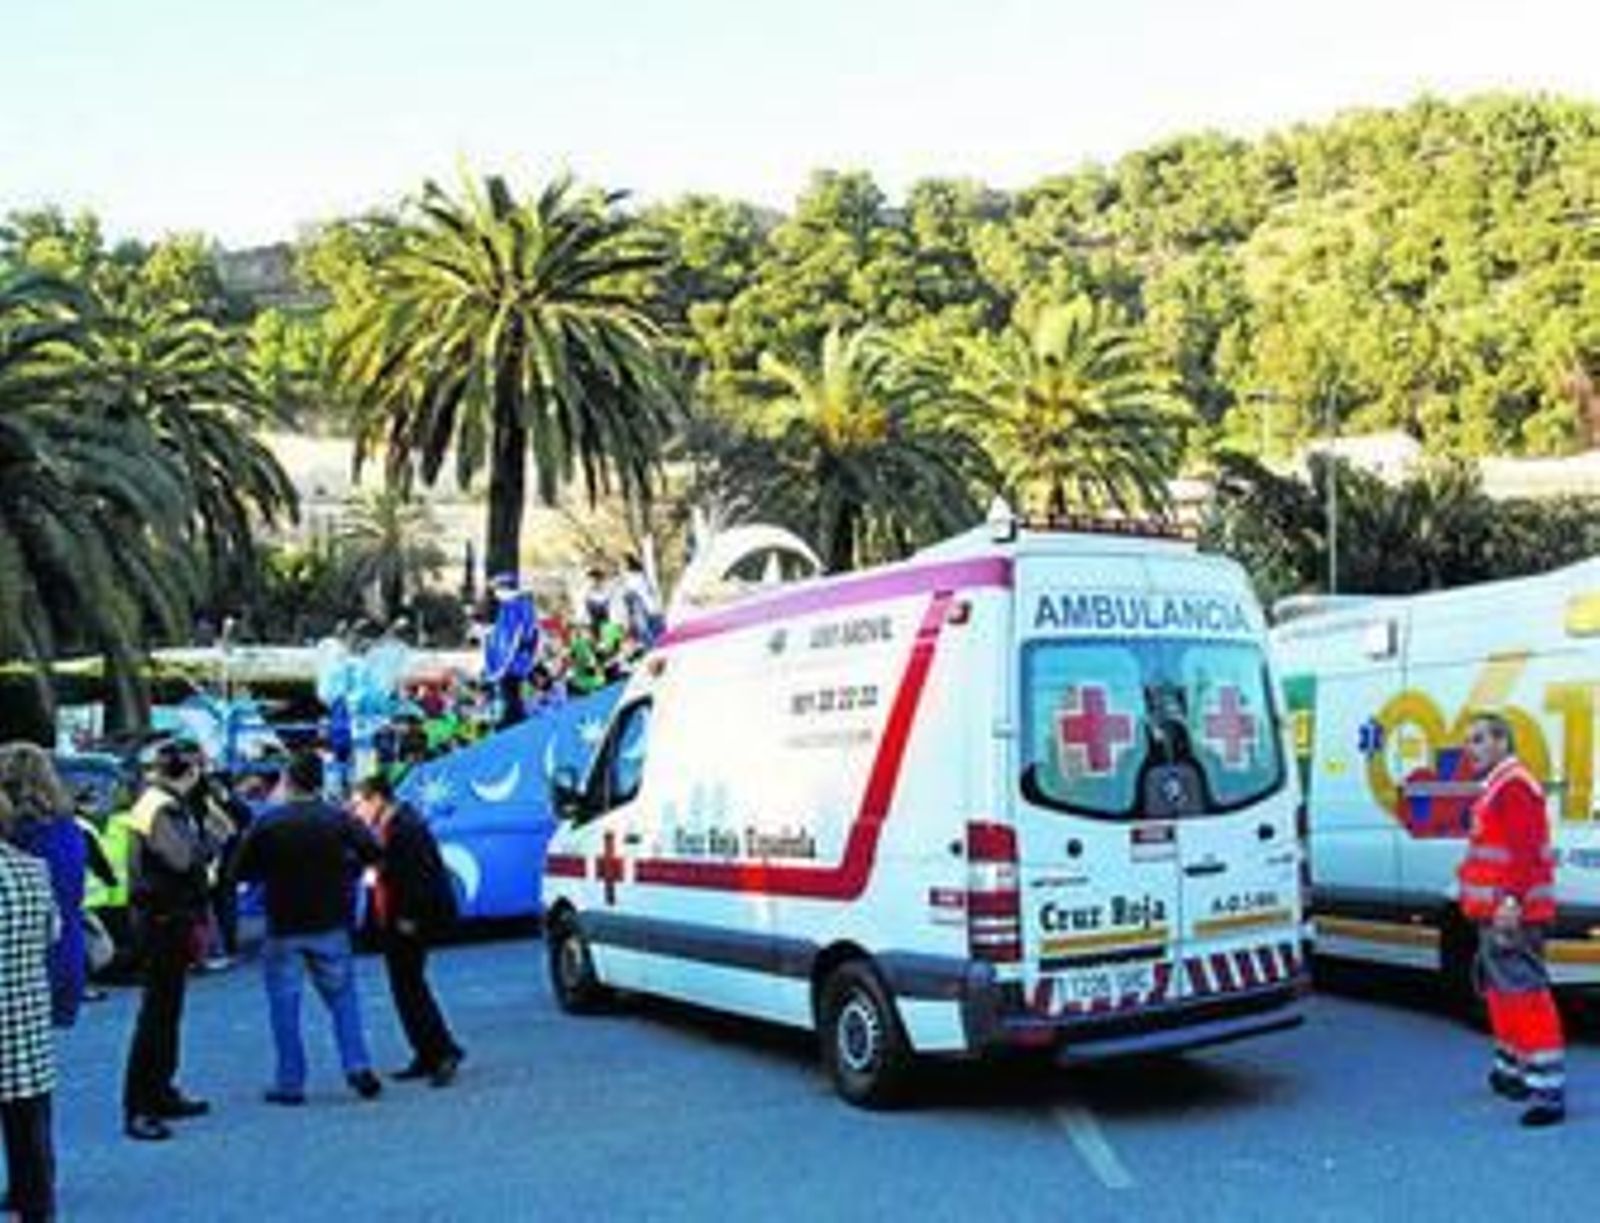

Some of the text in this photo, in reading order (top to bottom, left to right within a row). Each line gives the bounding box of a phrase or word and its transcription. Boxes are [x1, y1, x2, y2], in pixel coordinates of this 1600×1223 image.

[1034, 595, 1250, 631] AMBULANCIA
[1040, 895, 1165, 932] Cruz Roja
